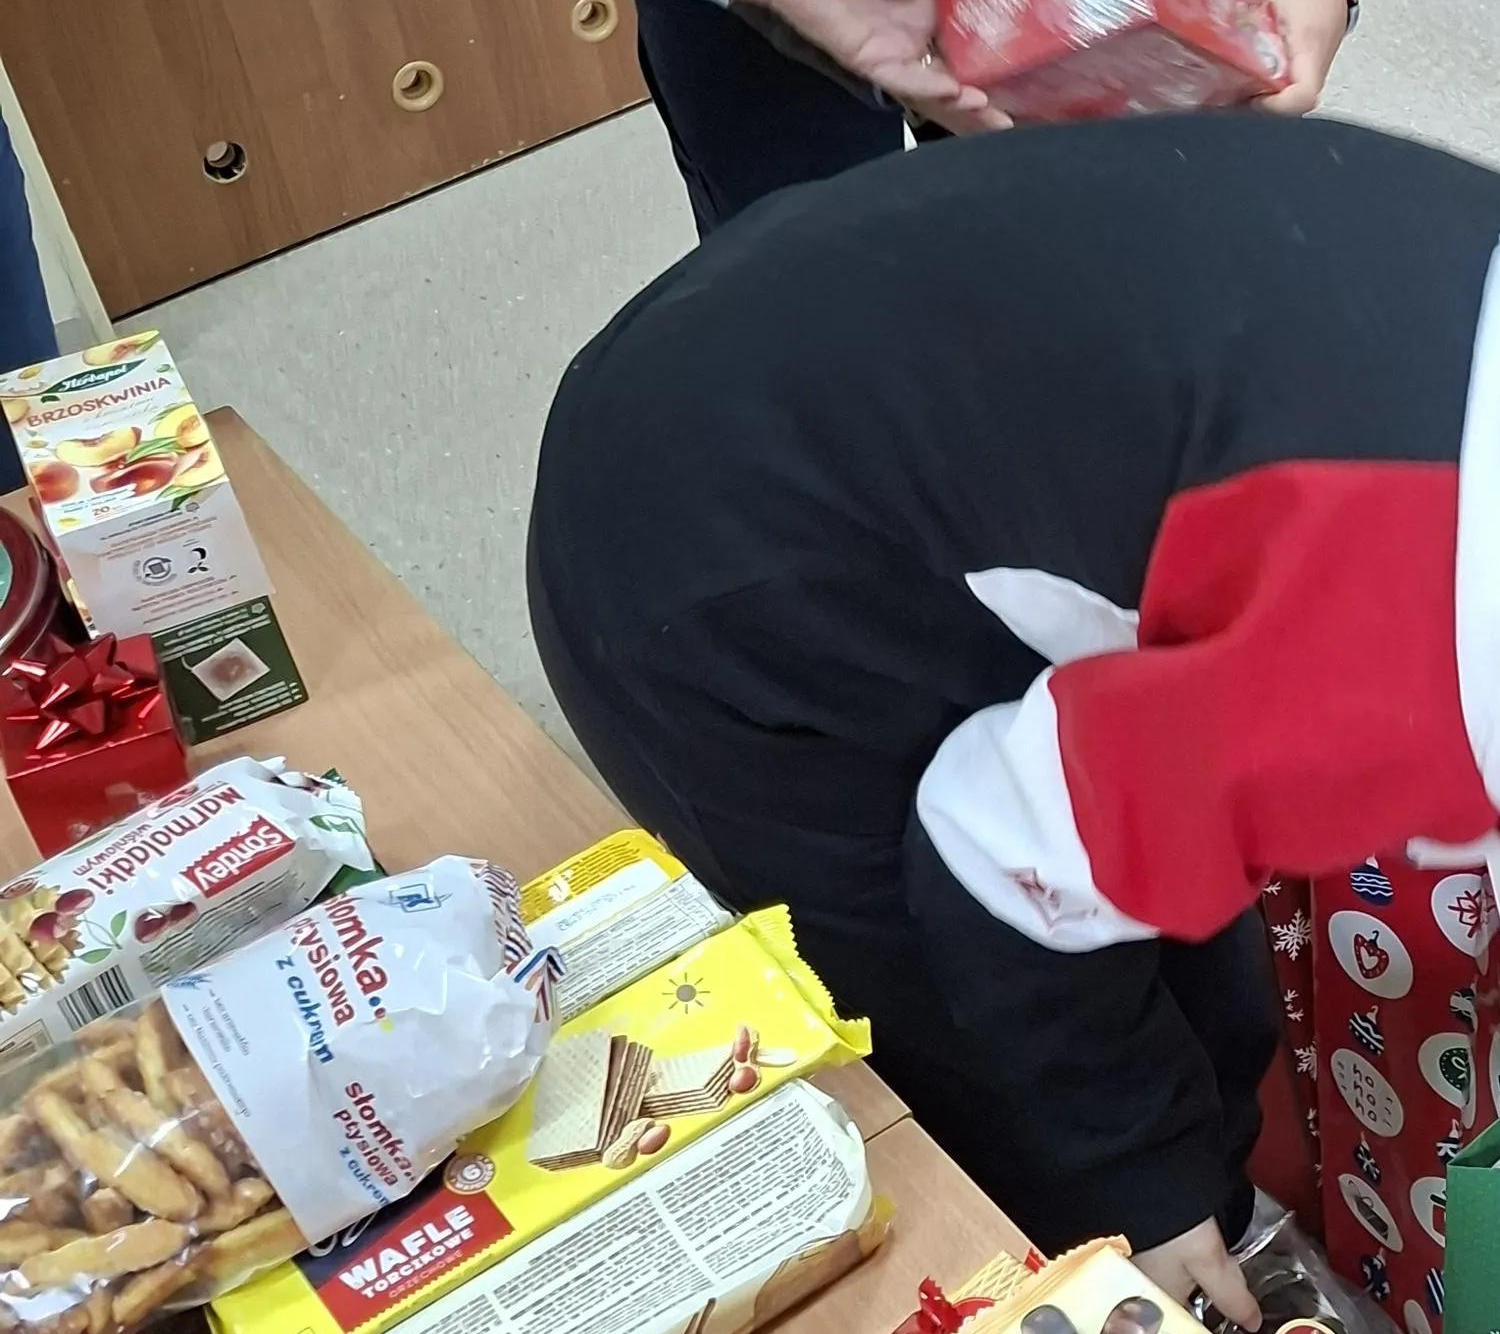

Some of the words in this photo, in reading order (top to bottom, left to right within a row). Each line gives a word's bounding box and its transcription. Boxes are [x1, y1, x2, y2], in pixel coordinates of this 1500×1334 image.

[27, 376, 172, 428] BRZOSKWINIA
[59, 364, 129, 392] Herbapol
[92, 505, 111, 517] 20
[88, 785, 246, 896] Marmoladki
[196, 825, 286, 891] Sondey
[276, 954, 295, 971] z
[333, 1108, 398, 1186] ptysiowa
[339, 1146, 351, 1158] z
[339, 1205, 476, 1291] WAFLE
[361, 1228, 475, 1299] TORCIKOWE
